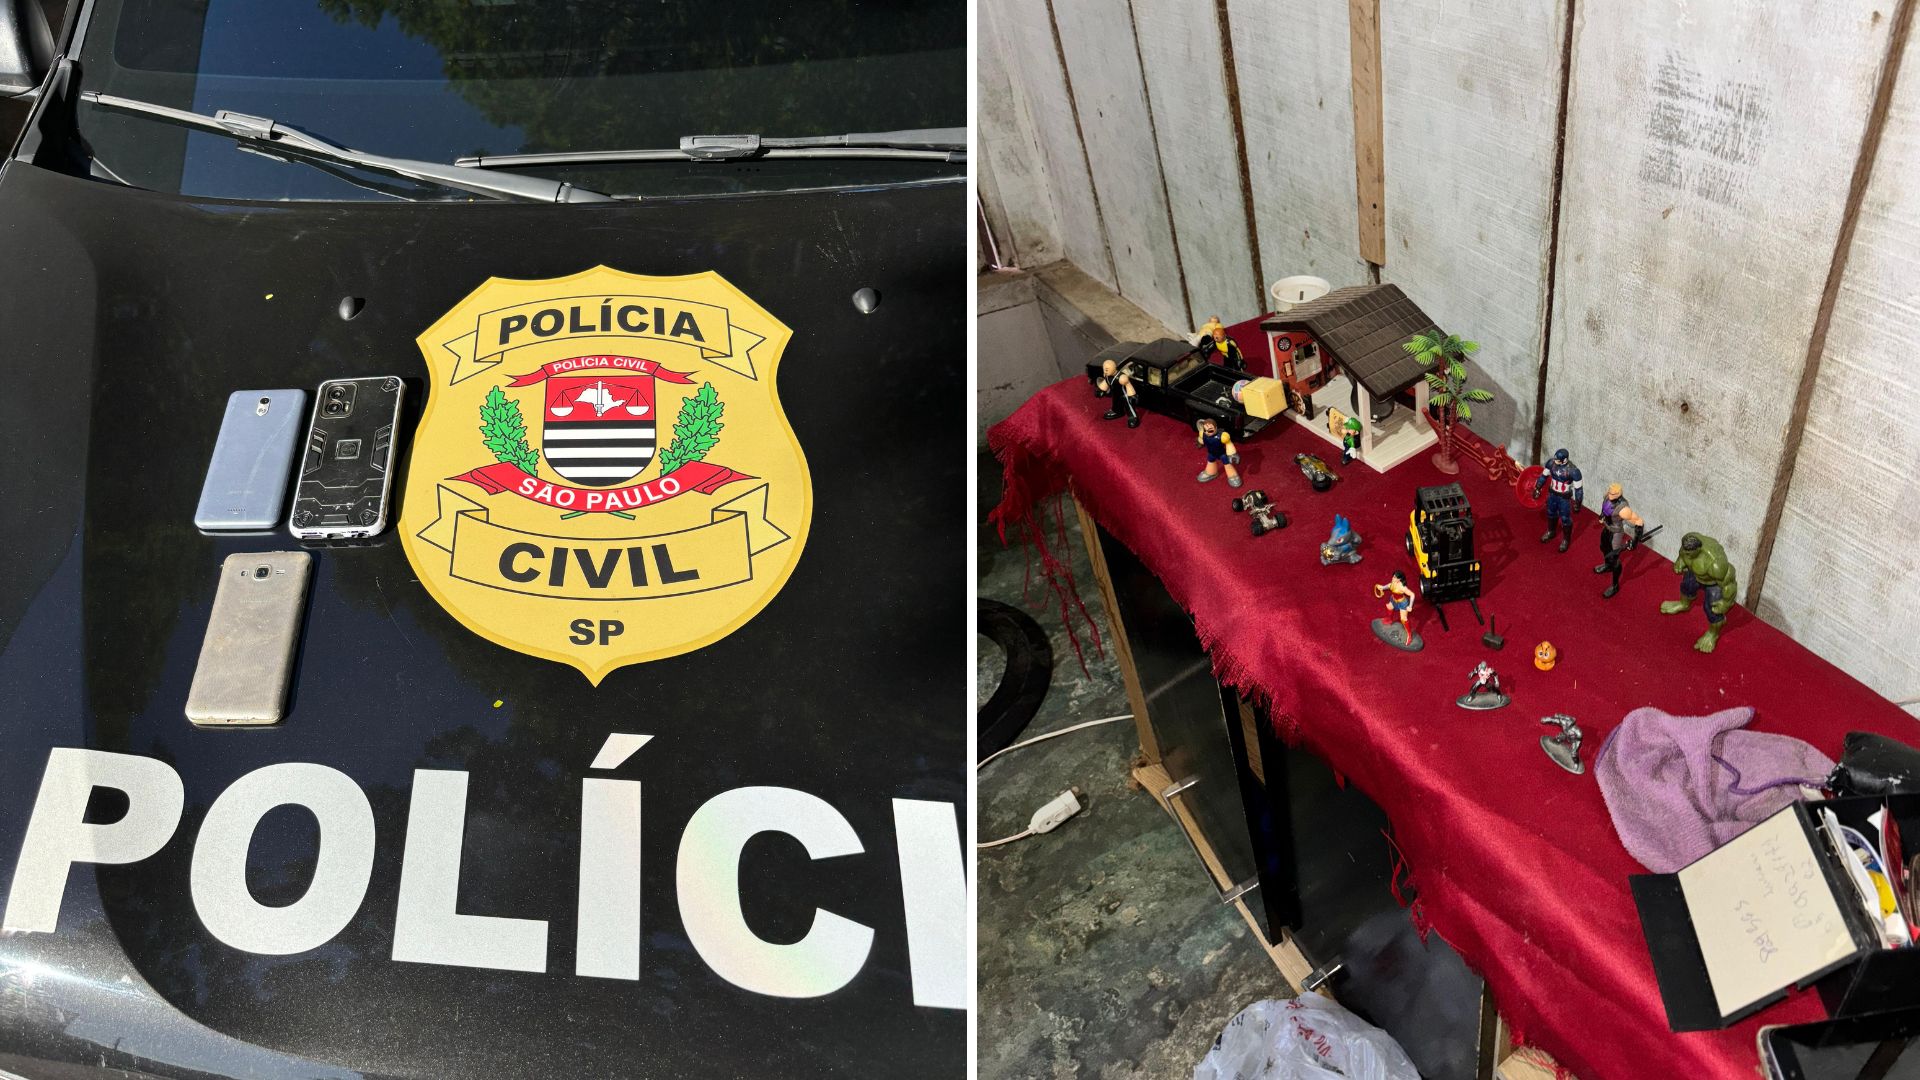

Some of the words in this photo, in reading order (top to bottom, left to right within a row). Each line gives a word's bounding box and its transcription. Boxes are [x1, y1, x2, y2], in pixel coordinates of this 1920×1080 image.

[498, 297, 706, 346] POLÍCIA
[552, 356, 610, 374] POLÍCIA
[612, 356, 651, 372] CIVIL
[517, 476, 576, 508] SÃO
[585, 476, 681, 511] PAULO
[498, 542, 701, 590] CIVIL
[568, 619, 626, 647] SP
